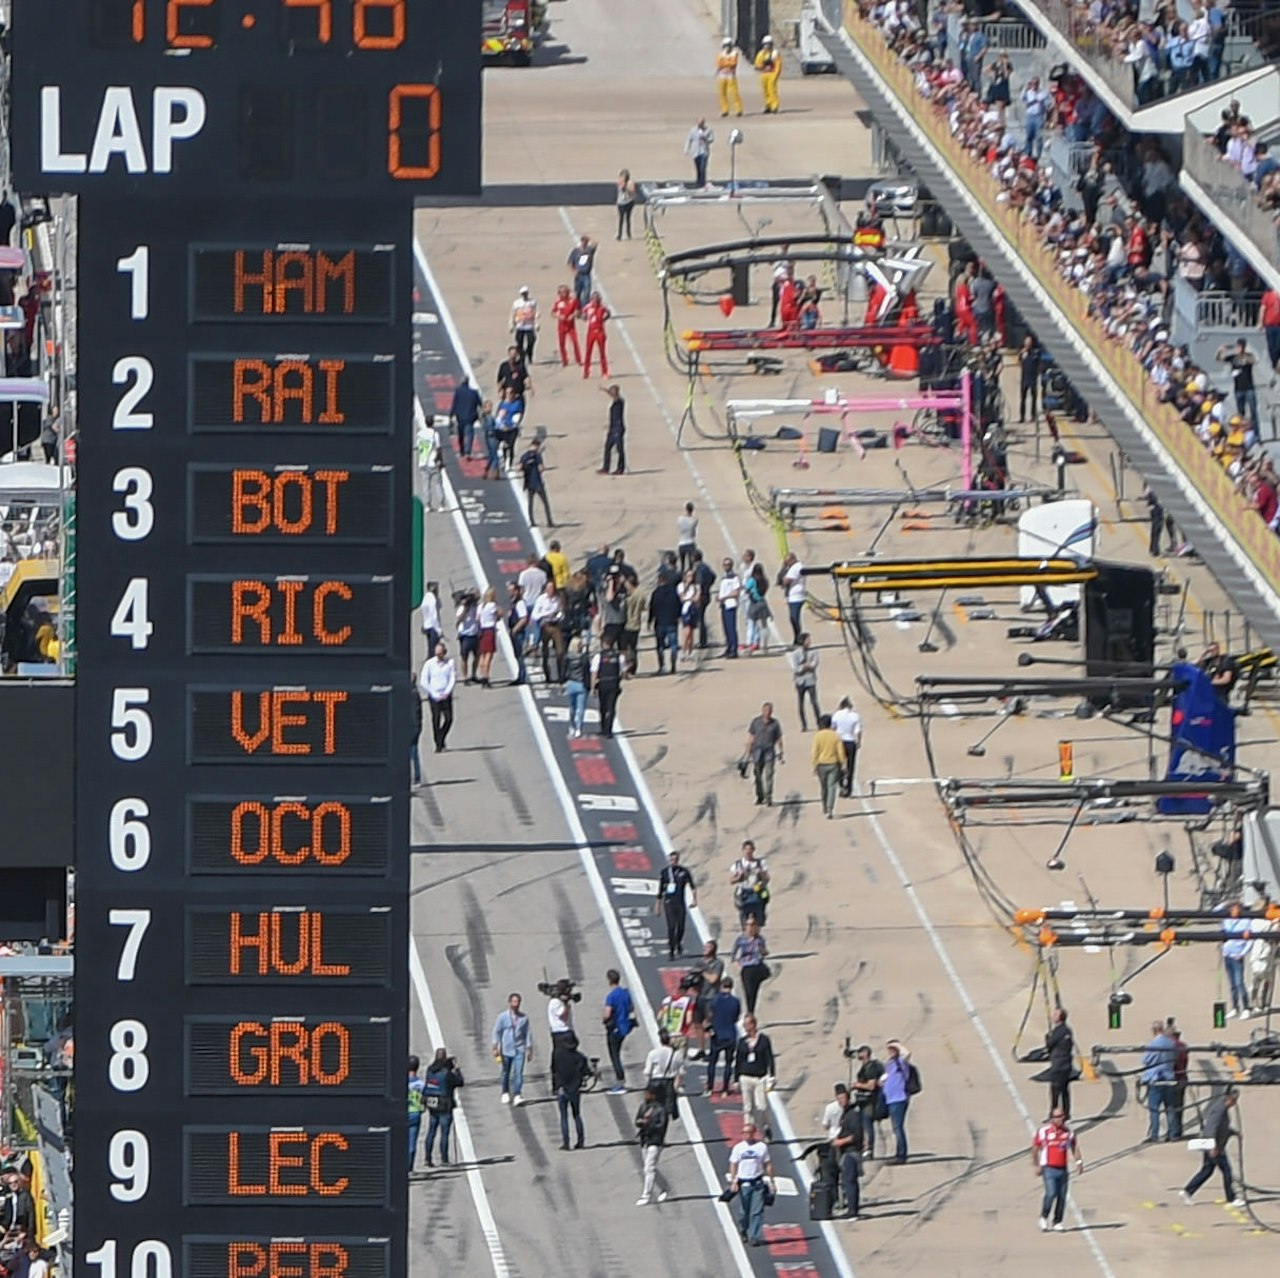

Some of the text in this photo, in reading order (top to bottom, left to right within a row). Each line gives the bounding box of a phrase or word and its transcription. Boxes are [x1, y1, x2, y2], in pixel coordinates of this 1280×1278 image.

[41, 84, 441, 179] LAP 0
[117, 246, 354, 319] 1 HAM
[112, 356, 345, 429] 2 RAI
[112, 467, 349, 540] 3 BOT
[111, 578, 352, 648] 4 RIC
[110, 688, 347, 760] 5 VET
[109, 798, 351, 871] 6 OCO
[109, 909, 350, 980] 7 HUL
[109, 1019, 349, 1091] 8 GRO
[109, 1130, 349, 1202] 9 LEC
